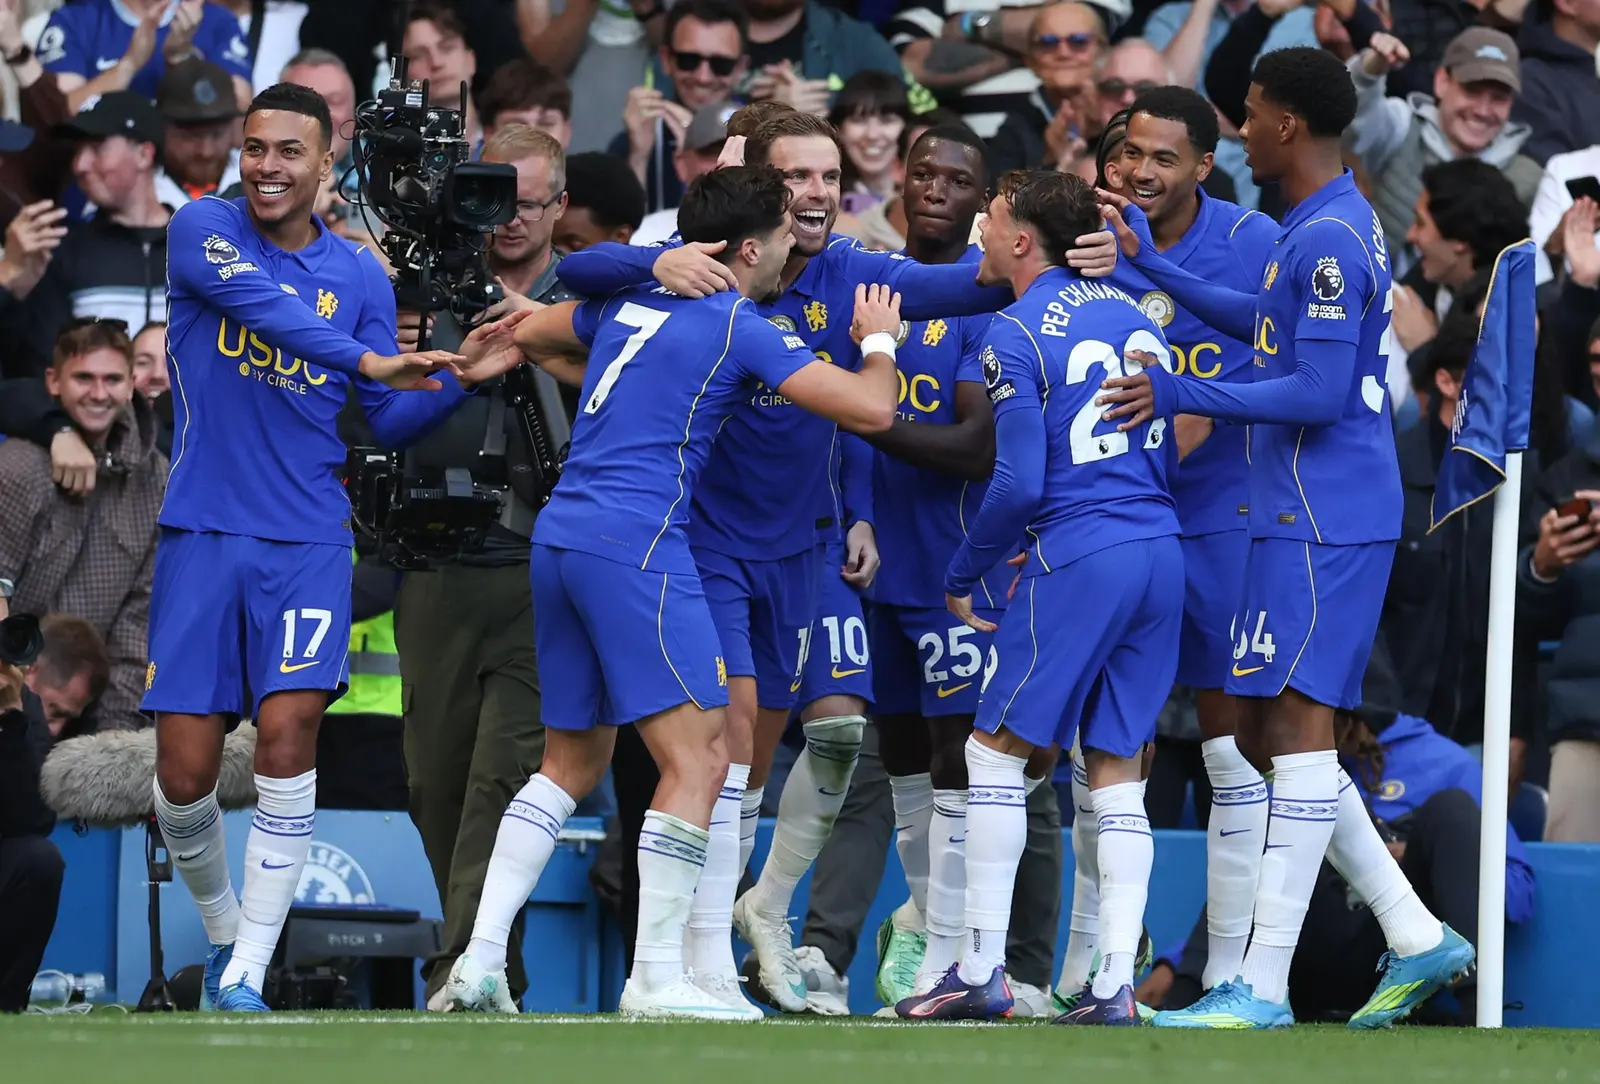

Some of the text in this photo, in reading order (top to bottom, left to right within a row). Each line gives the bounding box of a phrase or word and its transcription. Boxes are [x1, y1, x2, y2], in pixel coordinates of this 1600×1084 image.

[1041, 301, 1071, 337] PEP
[1308, 303, 1343, 313] No room
[1308, 310, 1346, 320] for racism
[583, 301, 672, 415] 7
[267, 374, 307, 395] CIRCLE
[282, 608, 332, 658] 17
[822, 616, 870, 666] 10
[918, 624, 982, 684] 25
[305, 846, 353, 882] LSEA
